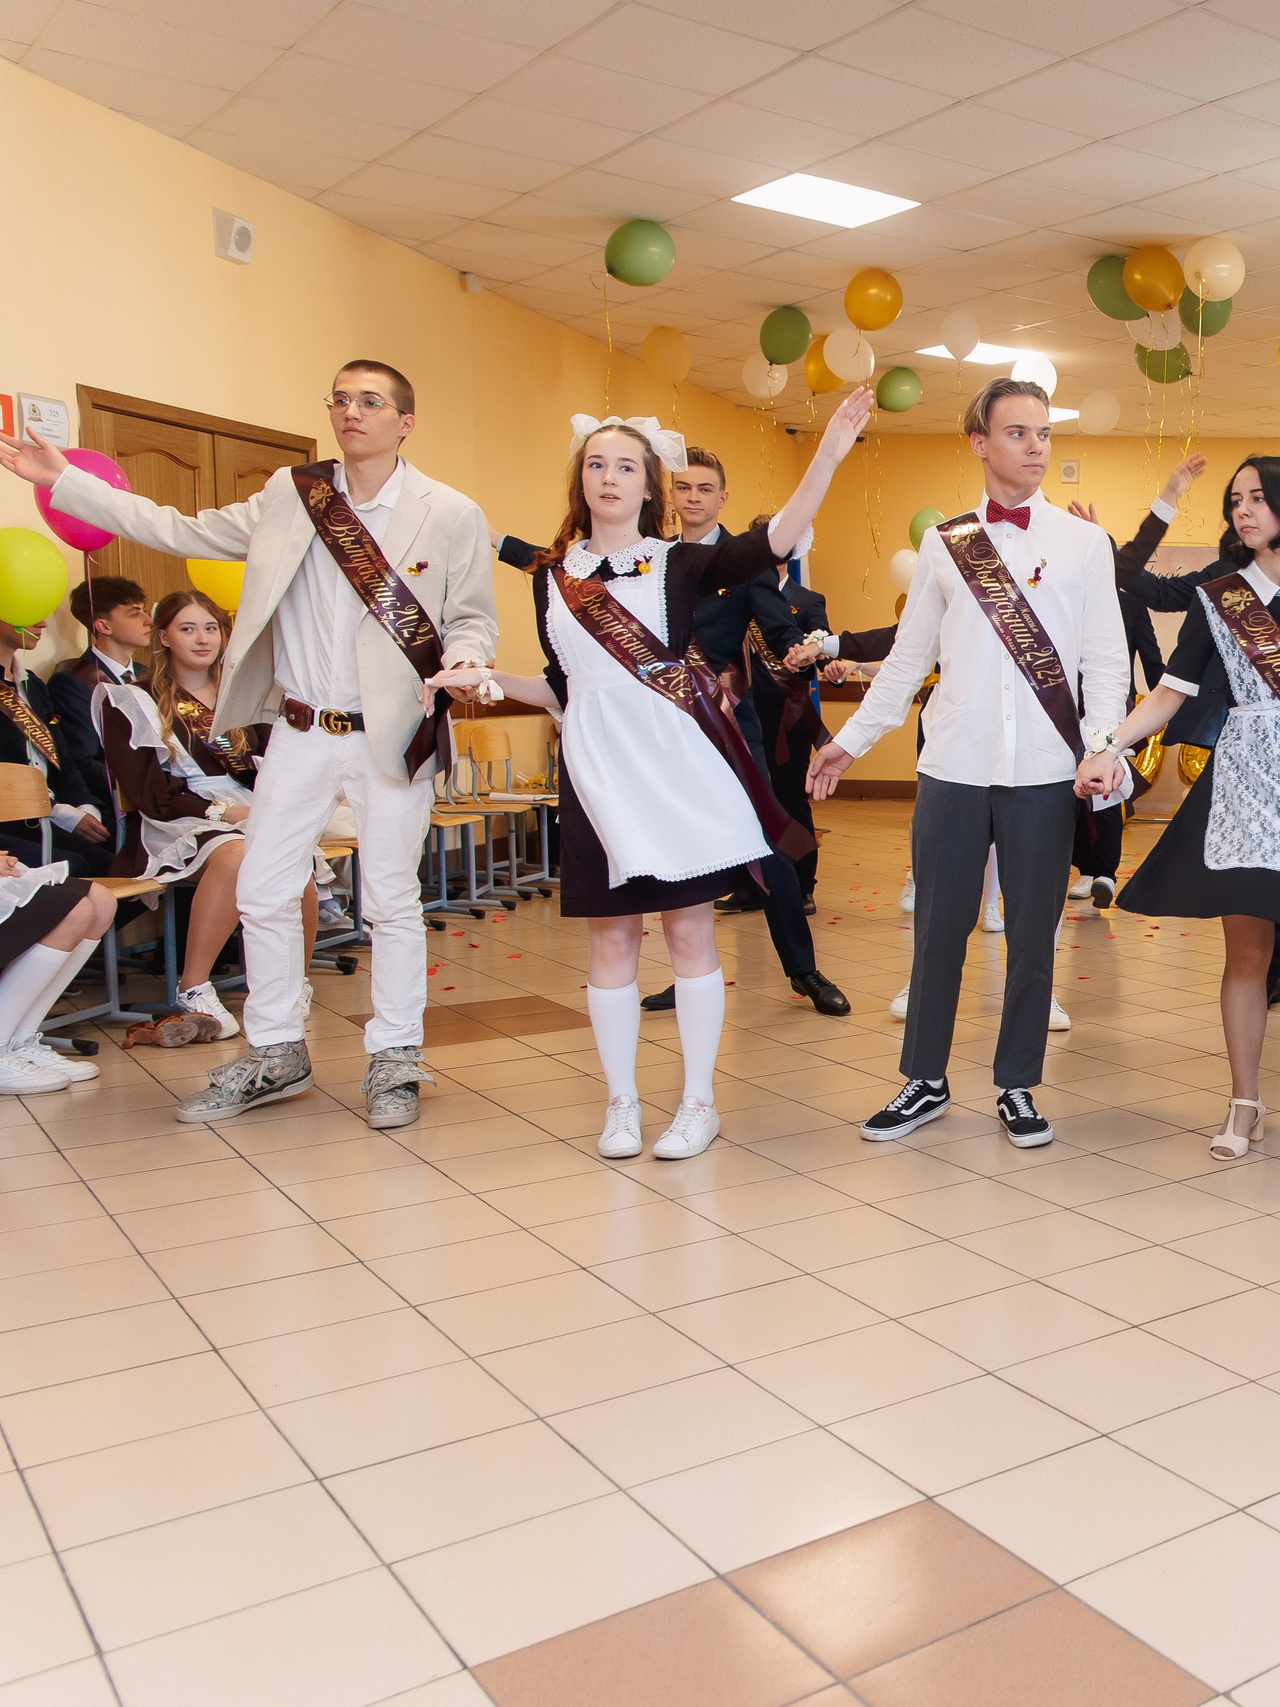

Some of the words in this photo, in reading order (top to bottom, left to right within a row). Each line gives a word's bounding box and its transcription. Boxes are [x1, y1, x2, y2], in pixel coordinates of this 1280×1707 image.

[323, 505, 400, 610] Выпускник
[386, 604, 434, 646] 2024
[577, 580, 666, 675] Выпускница
[965, 541, 1038, 652] Выпускник
[1025, 646, 1066, 688] 2024
